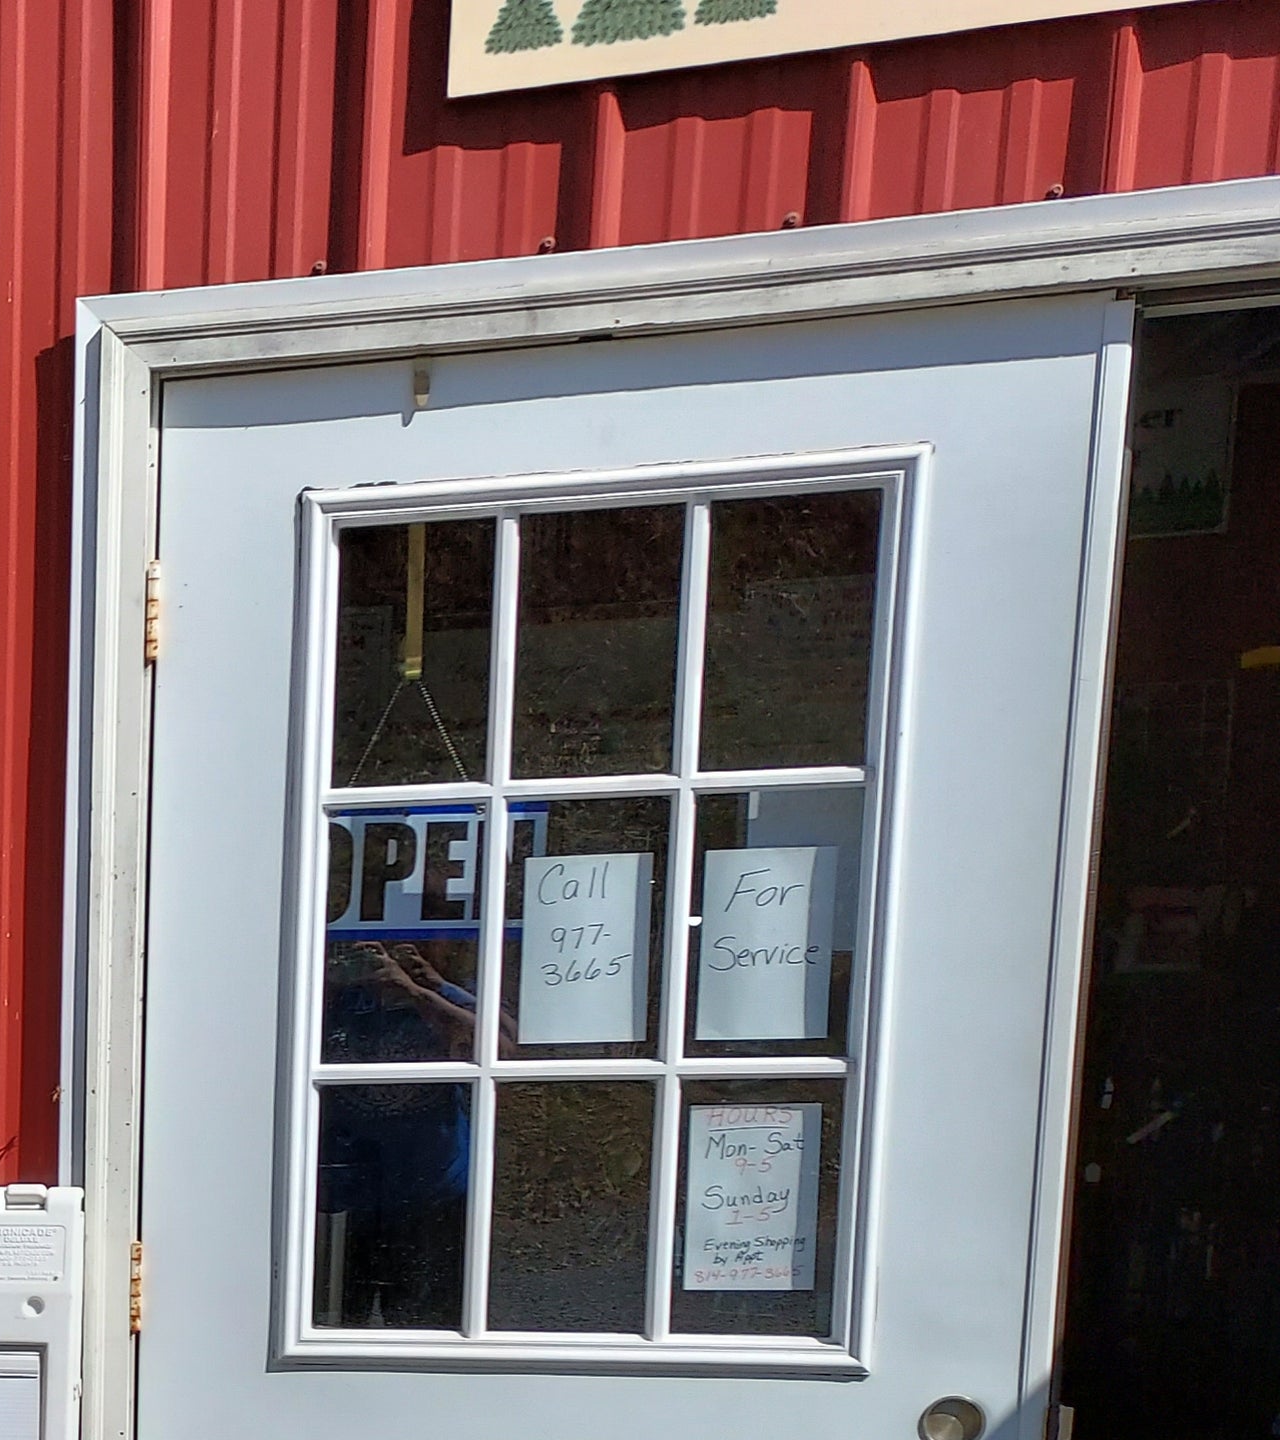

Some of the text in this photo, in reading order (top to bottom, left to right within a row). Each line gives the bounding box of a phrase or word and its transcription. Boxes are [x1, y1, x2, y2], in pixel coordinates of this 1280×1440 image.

[537, 864, 608, 908] Call
[724, 867, 804, 914] For
[707, 935, 820, 973] Service
[541, 952, 632, 988] 3665
[707, 1106, 793, 1127] HOURS
[763, 1131, 806, 1155] Sat
[734, 1155, 775, 1177] 9-5
[701, 1185, 790, 1214] Sunday
[703, 1234, 807, 1255] Evening Shopping
[712, 1252, 729, 1265] by
